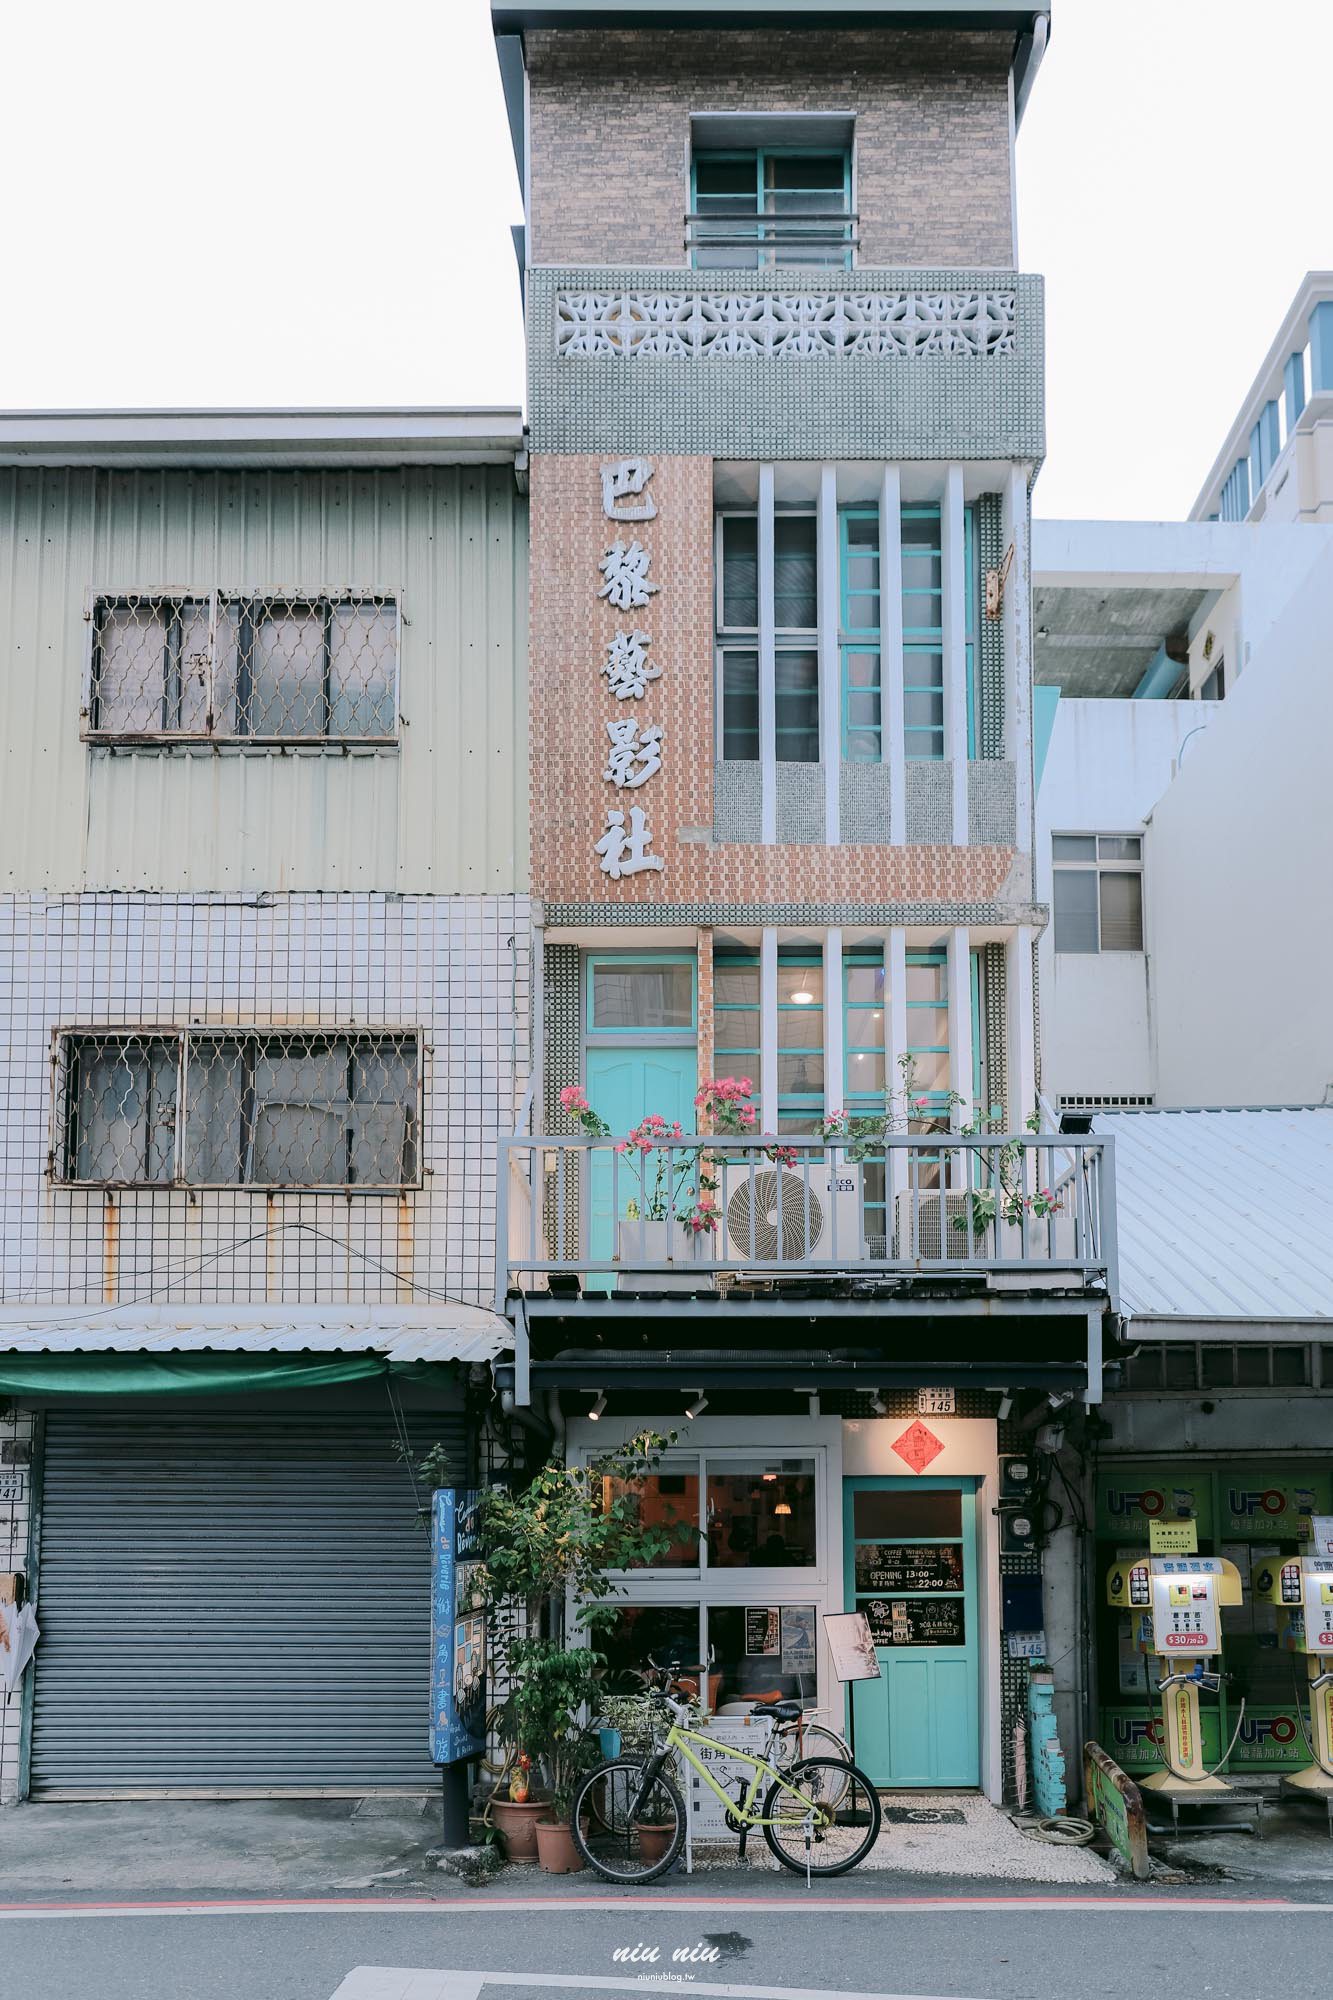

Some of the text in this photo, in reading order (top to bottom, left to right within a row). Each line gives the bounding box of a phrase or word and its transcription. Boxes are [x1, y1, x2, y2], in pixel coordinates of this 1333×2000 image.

[595, 457, 664, 880] 巴黎藝影社
[931, 1401, 951, 1411] 145
[0, 1488, 17, 1498] 41
[1107, 1488, 1166, 1516] UFO
[1229, 1488, 1288, 1516] UFO
[869, 1571, 903, 1580] OPENING
[918, 1580, 943, 1588] 22:00
[1321, 1634, 1333, 1643] $3
[1022, 1645, 1042, 1655] 145
[1112, 1717, 1165, 1745] UFO
[1238, 1716, 1298, 1745] UFO
[700, 1747, 754, 1760] 街角店
[1240, 1747, 1299, 1759] 優福加水站
